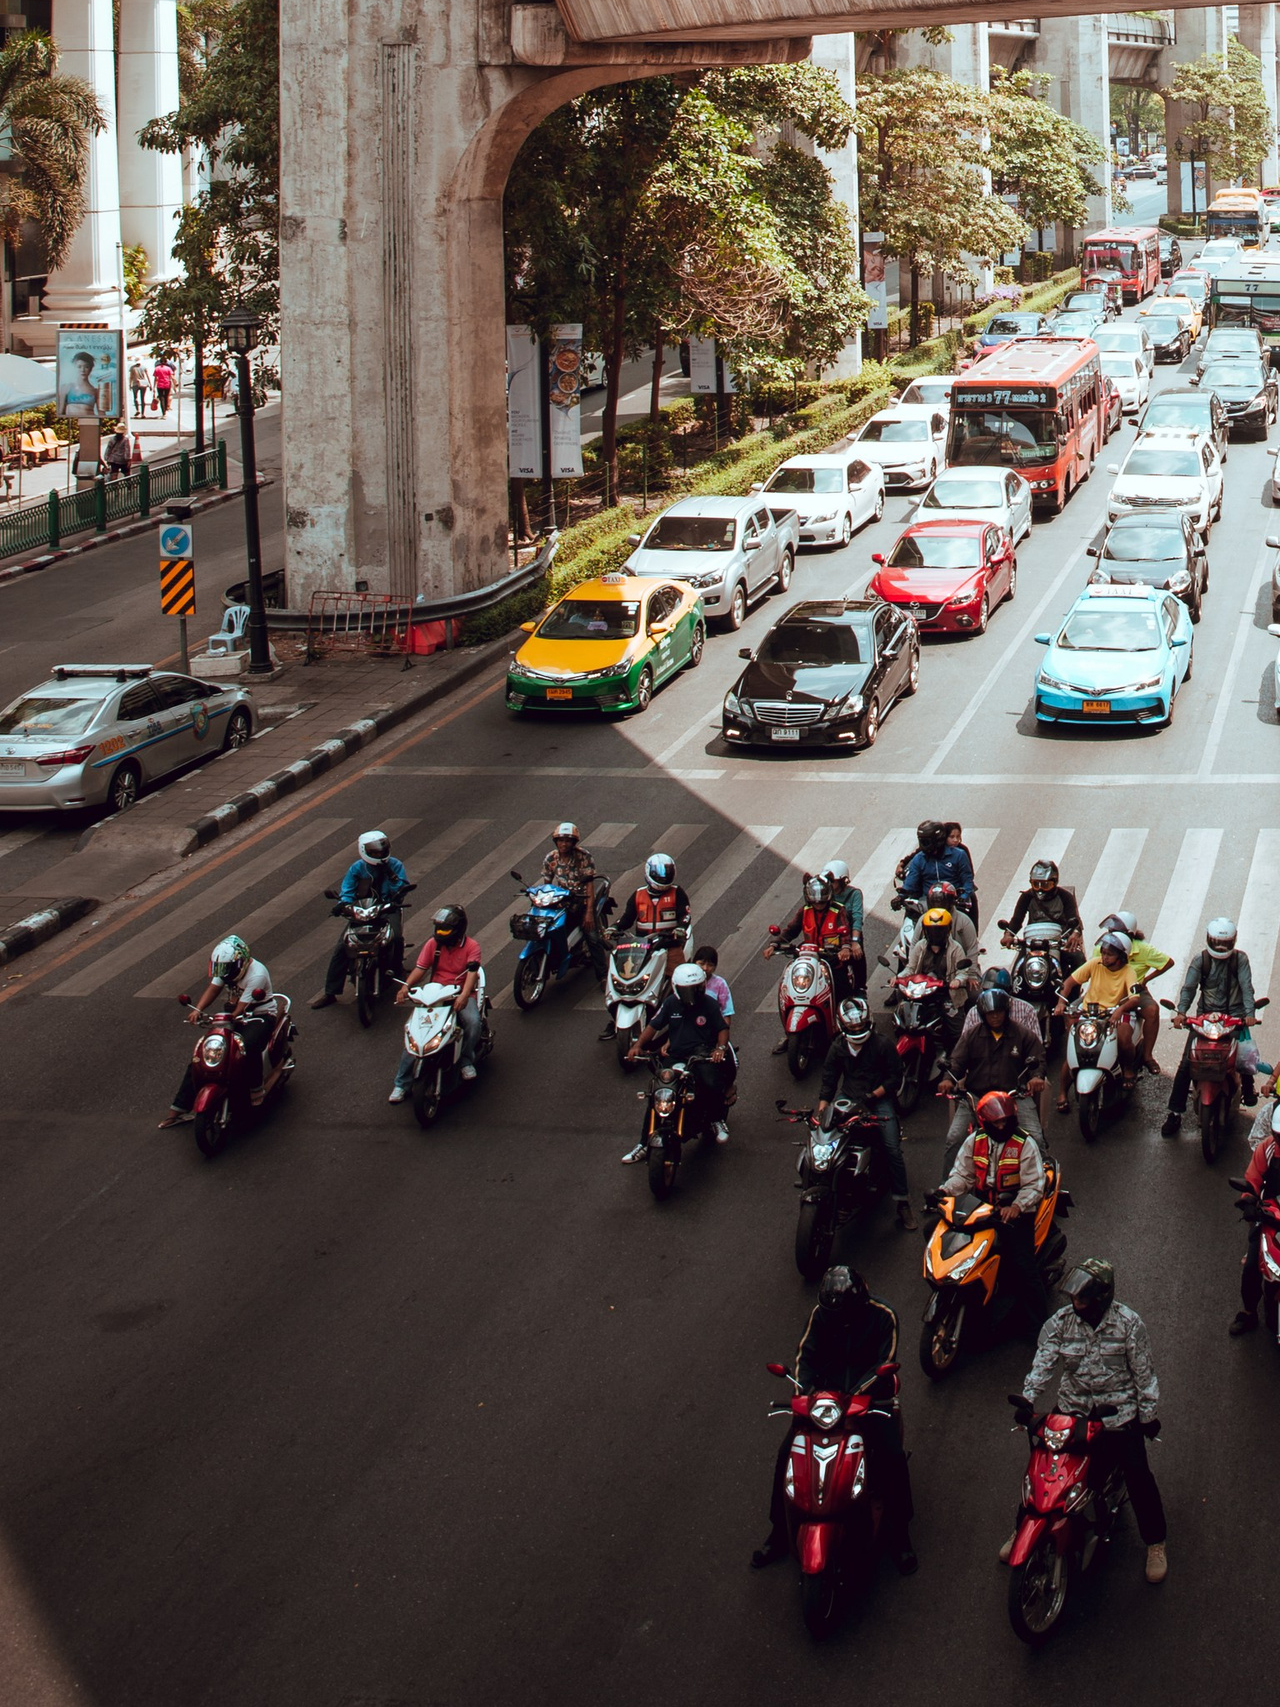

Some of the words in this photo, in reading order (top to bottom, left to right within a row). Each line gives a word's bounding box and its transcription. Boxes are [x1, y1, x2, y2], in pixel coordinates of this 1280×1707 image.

[1245, 284, 1259, 292] 77
[77, 335, 114, 343] ANESSA
[993, 390, 1012, 404] 77
[1040, 393, 1046, 403] 2
[99, 734, 126, 756] 1202
